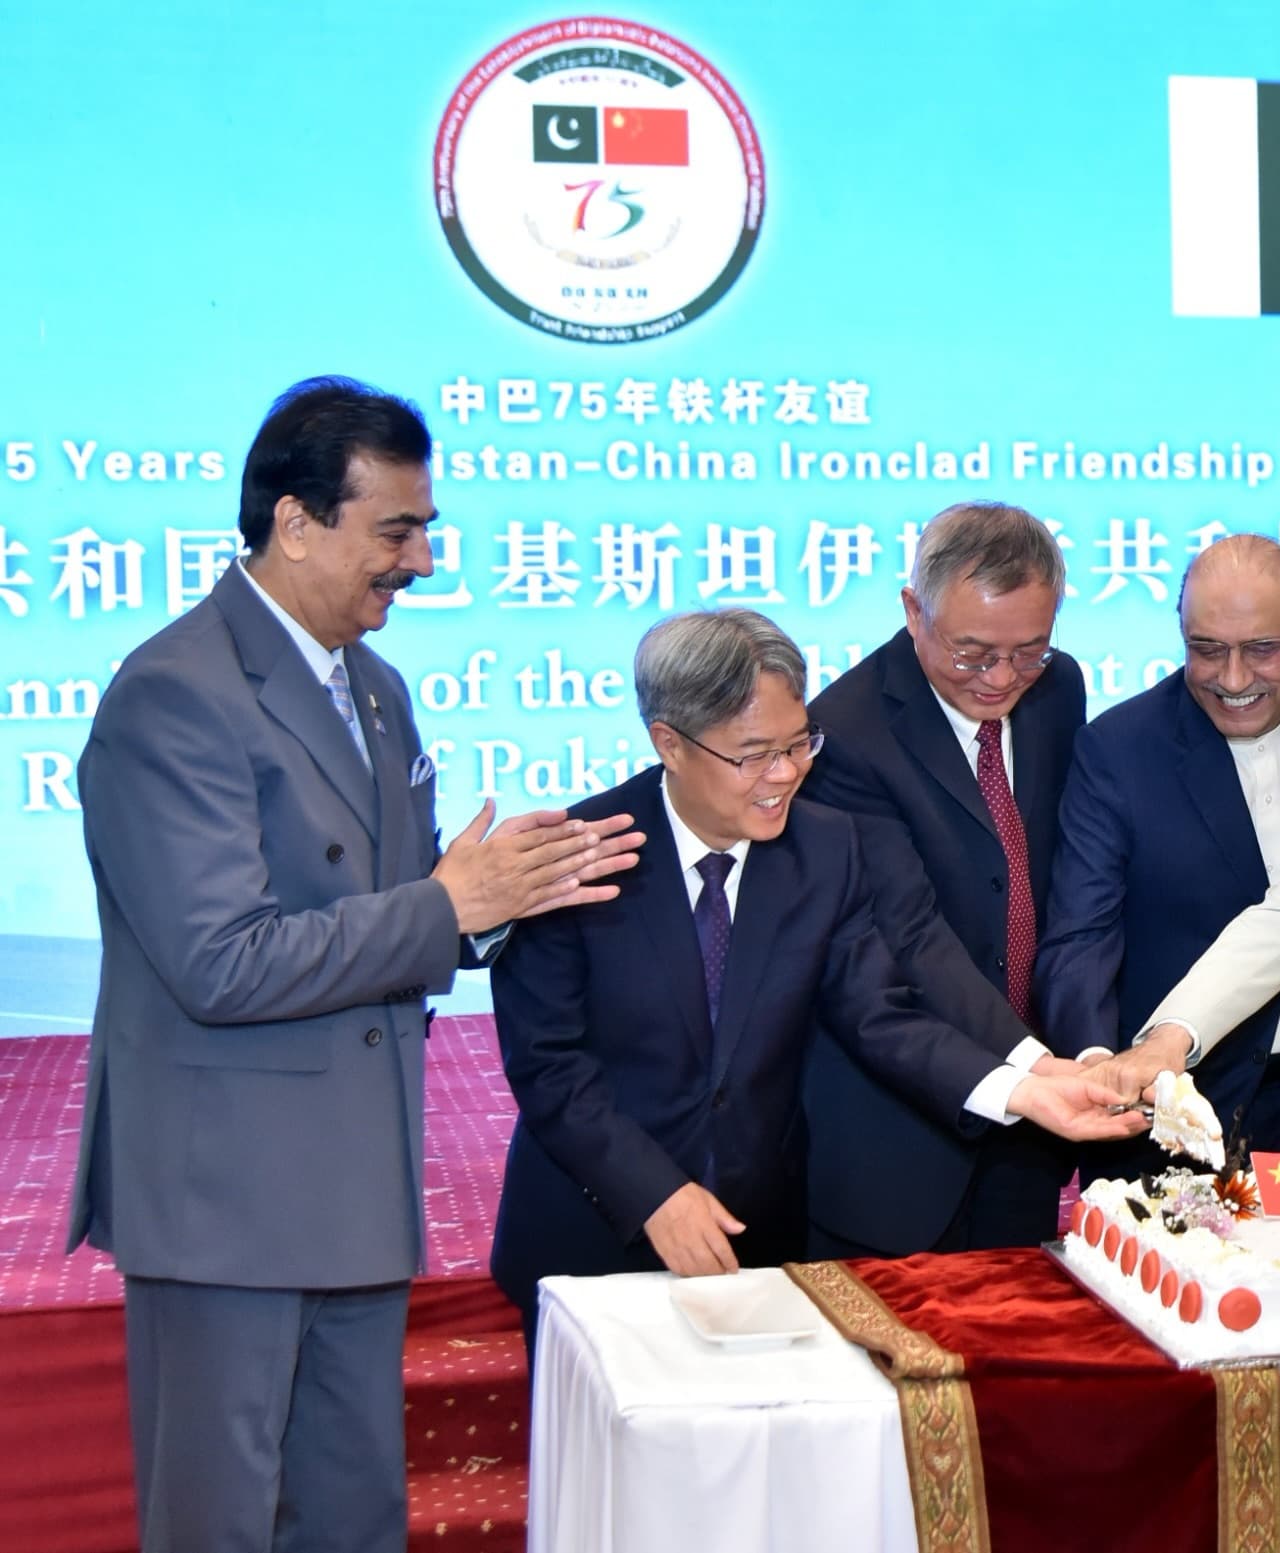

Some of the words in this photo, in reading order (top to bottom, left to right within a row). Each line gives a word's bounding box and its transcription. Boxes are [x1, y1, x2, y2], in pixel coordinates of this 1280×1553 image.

[563, 179, 646, 240] 75
[440, 376, 872, 425] 中巴75年铁杆友谊
[61, 439, 226, 481] Years
[431, 440, 757, 481] istan-China
[780, 440, 990, 480] Ironclad
[1012, 441, 1274, 487] Friendship
[419, 649, 496, 711] of
[514, 649, 624, 709] the
[473, 737, 658, 797] Paki
